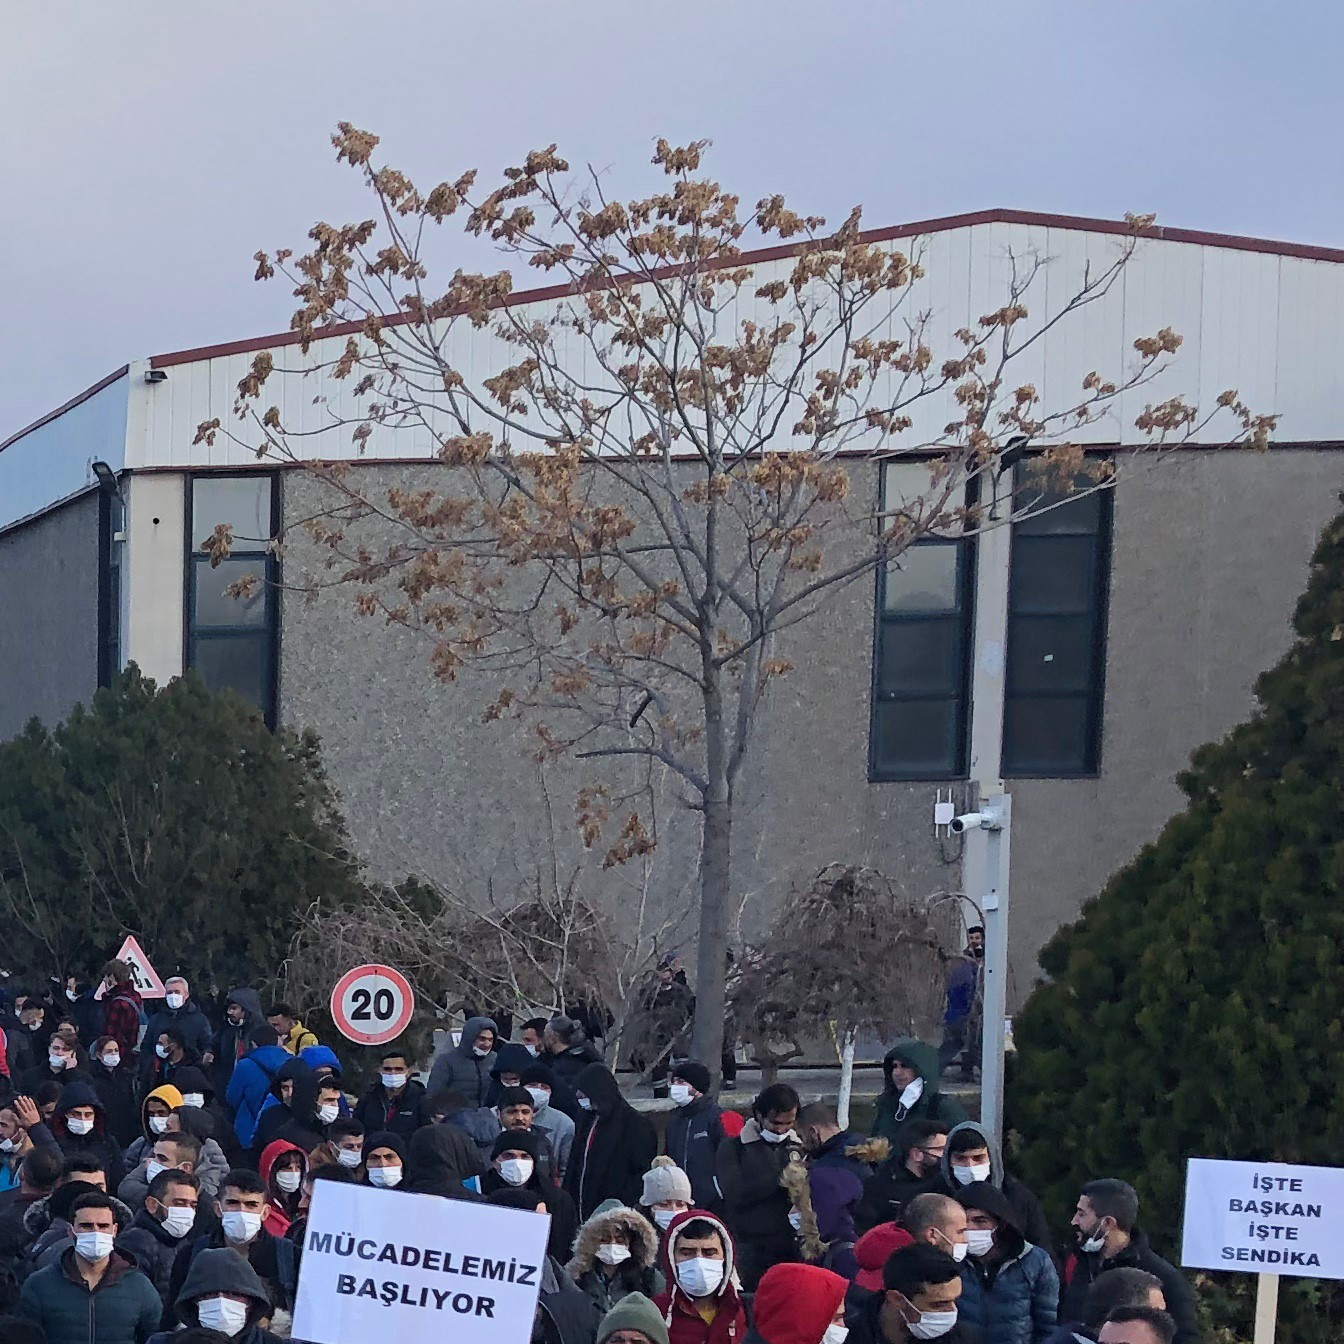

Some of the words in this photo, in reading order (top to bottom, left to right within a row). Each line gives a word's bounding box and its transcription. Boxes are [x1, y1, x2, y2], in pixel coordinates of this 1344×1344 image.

[351, 988, 394, 1020] 20
[1253, 1172, 1303, 1193] İŞTE
[1229, 1199, 1322, 1217] BAŞKAN
[1248, 1221, 1298, 1241] İŞTE
[308, 1231, 538, 1286] MÜCADELEMİZ
[1221, 1246, 1321, 1266] SENDİKA
[336, 1274, 495, 1318] BAŞLIYOR
